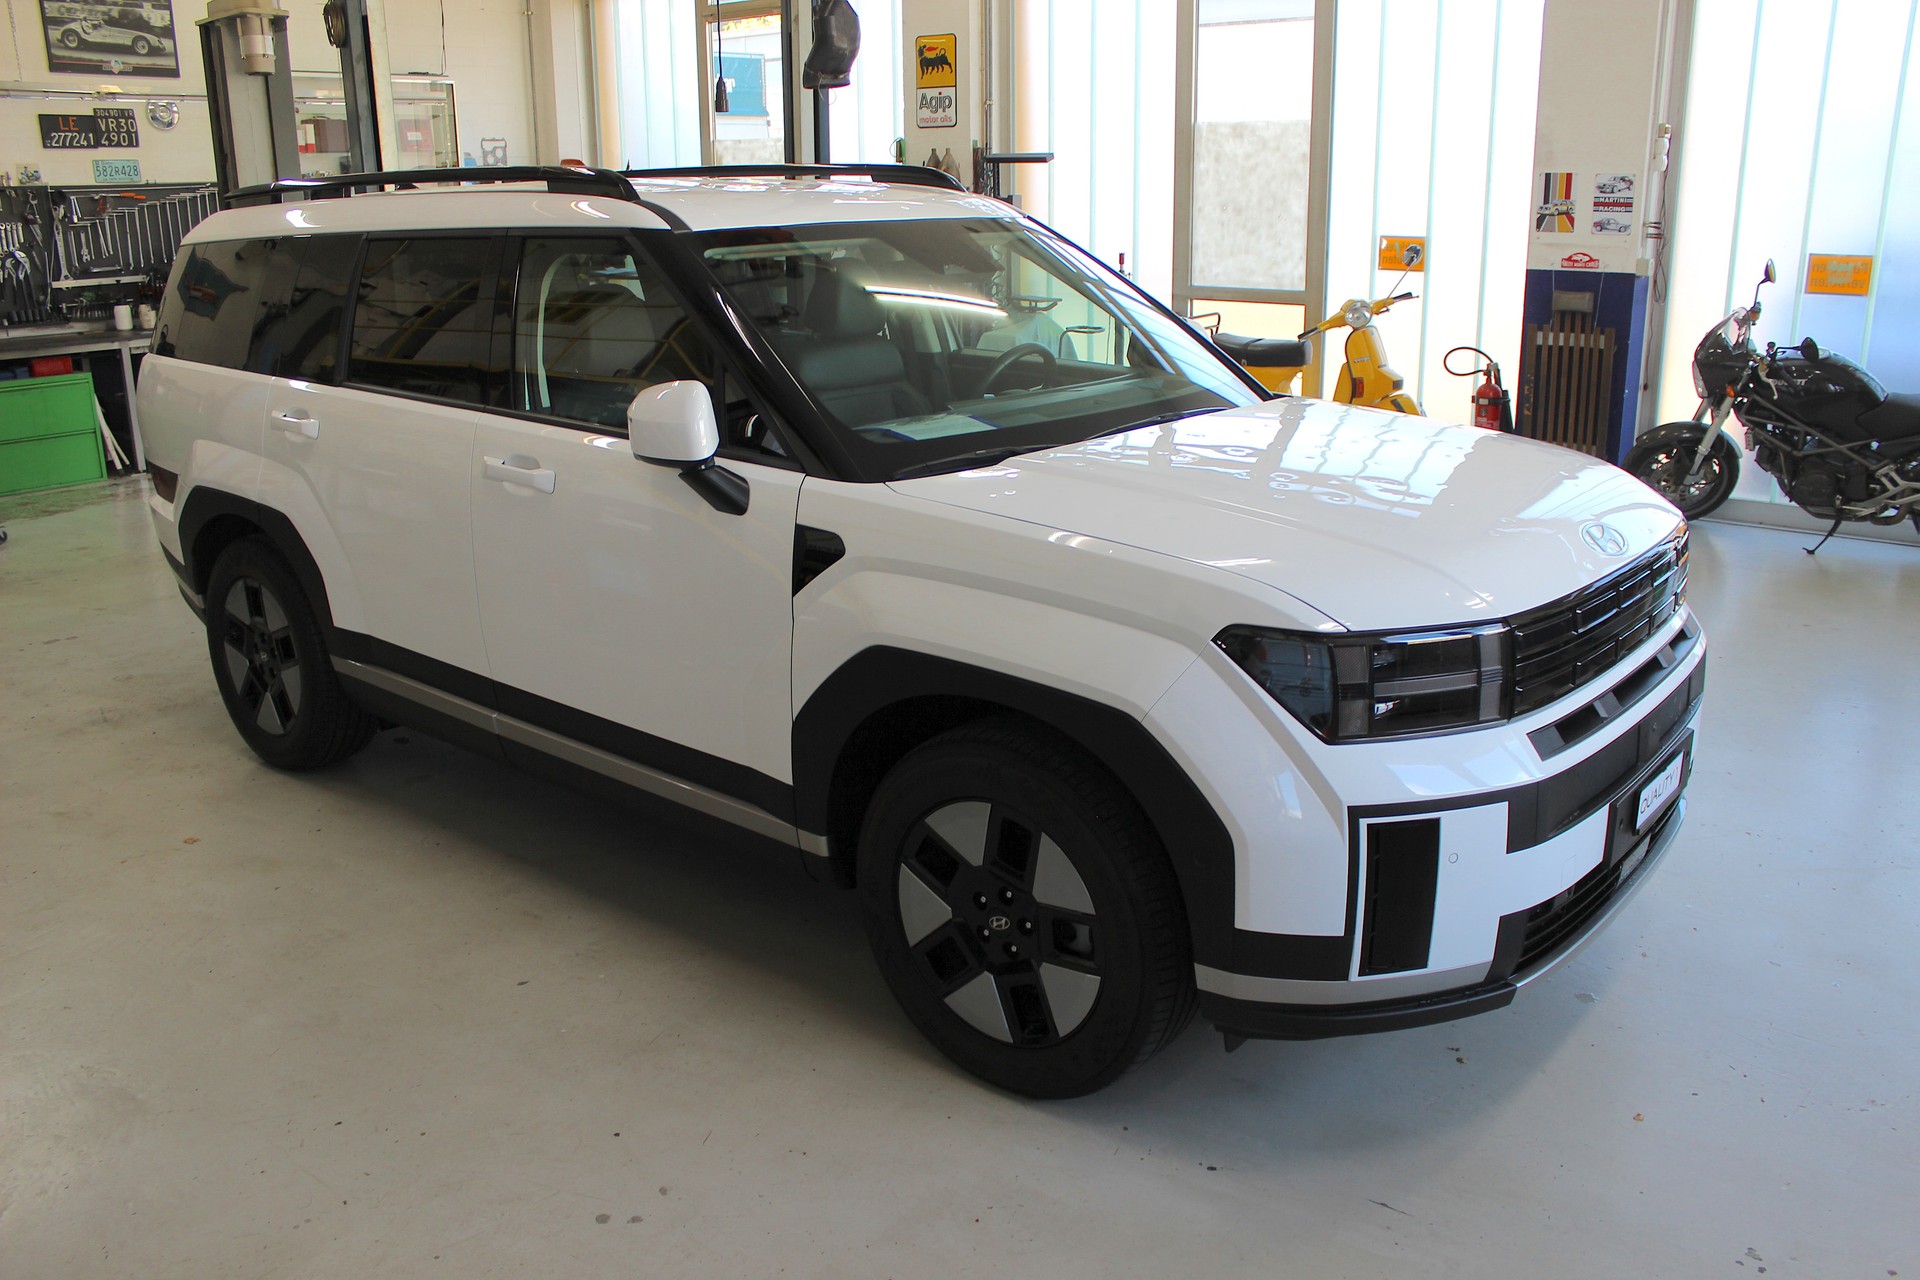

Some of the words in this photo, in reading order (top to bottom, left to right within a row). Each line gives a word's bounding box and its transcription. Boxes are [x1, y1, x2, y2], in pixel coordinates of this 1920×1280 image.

[919, 91, 953, 114] Agip
[58, 116, 79, 131] LE
[98, 118, 136, 132] VR30
[940, 115, 952, 123] oils
[51, 132, 95, 147] 277241
[101, 132, 136, 146] 4901
[95, 165, 139, 177] 582R428
[1640, 770, 1675, 815] QUALITY
